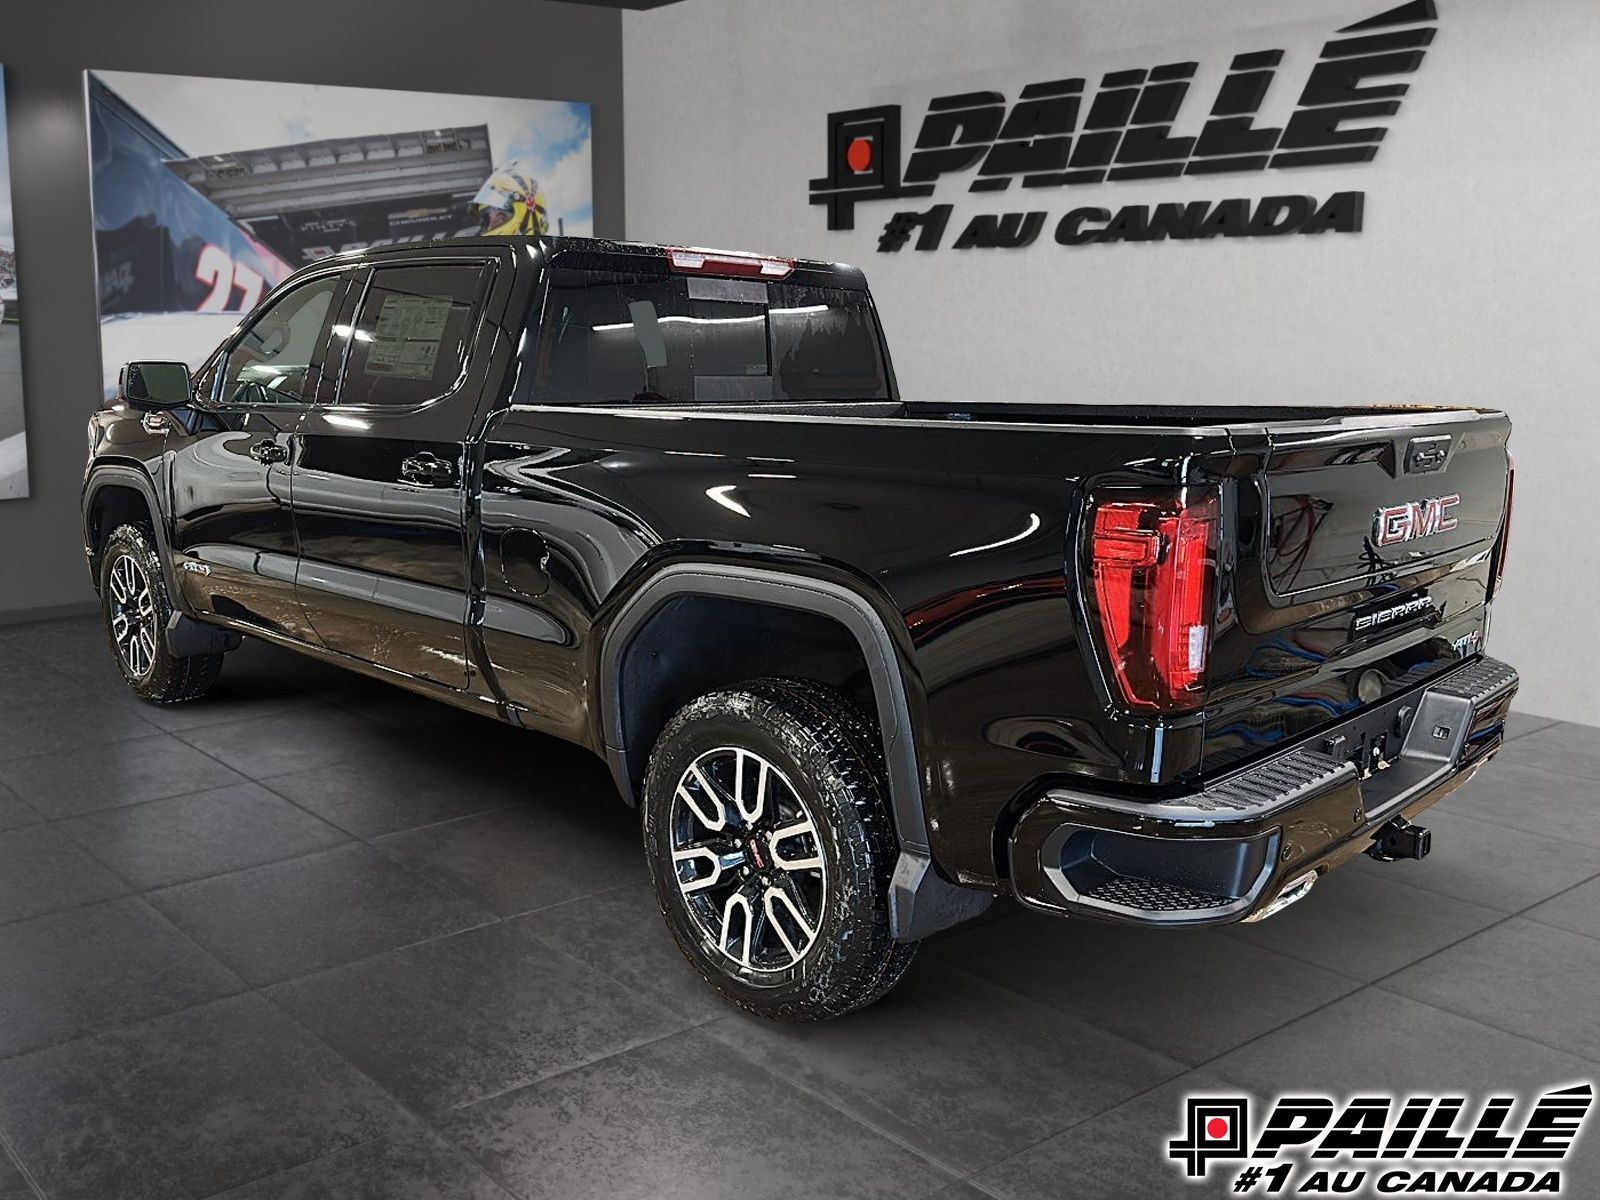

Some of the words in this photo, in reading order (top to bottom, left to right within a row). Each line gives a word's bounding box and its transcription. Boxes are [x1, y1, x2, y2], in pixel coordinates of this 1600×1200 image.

[901, 0, 1438, 196] PAILLÉ
[877, 204, 954, 253] #1
[952, 210, 1048, 250] AU
[1054, 190, 1365, 246] CANADA
[196, 243, 265, 314] 27
[1374, 493, 1461, 547] GMC
[1355, 596, 1433, 631] SIERRA
